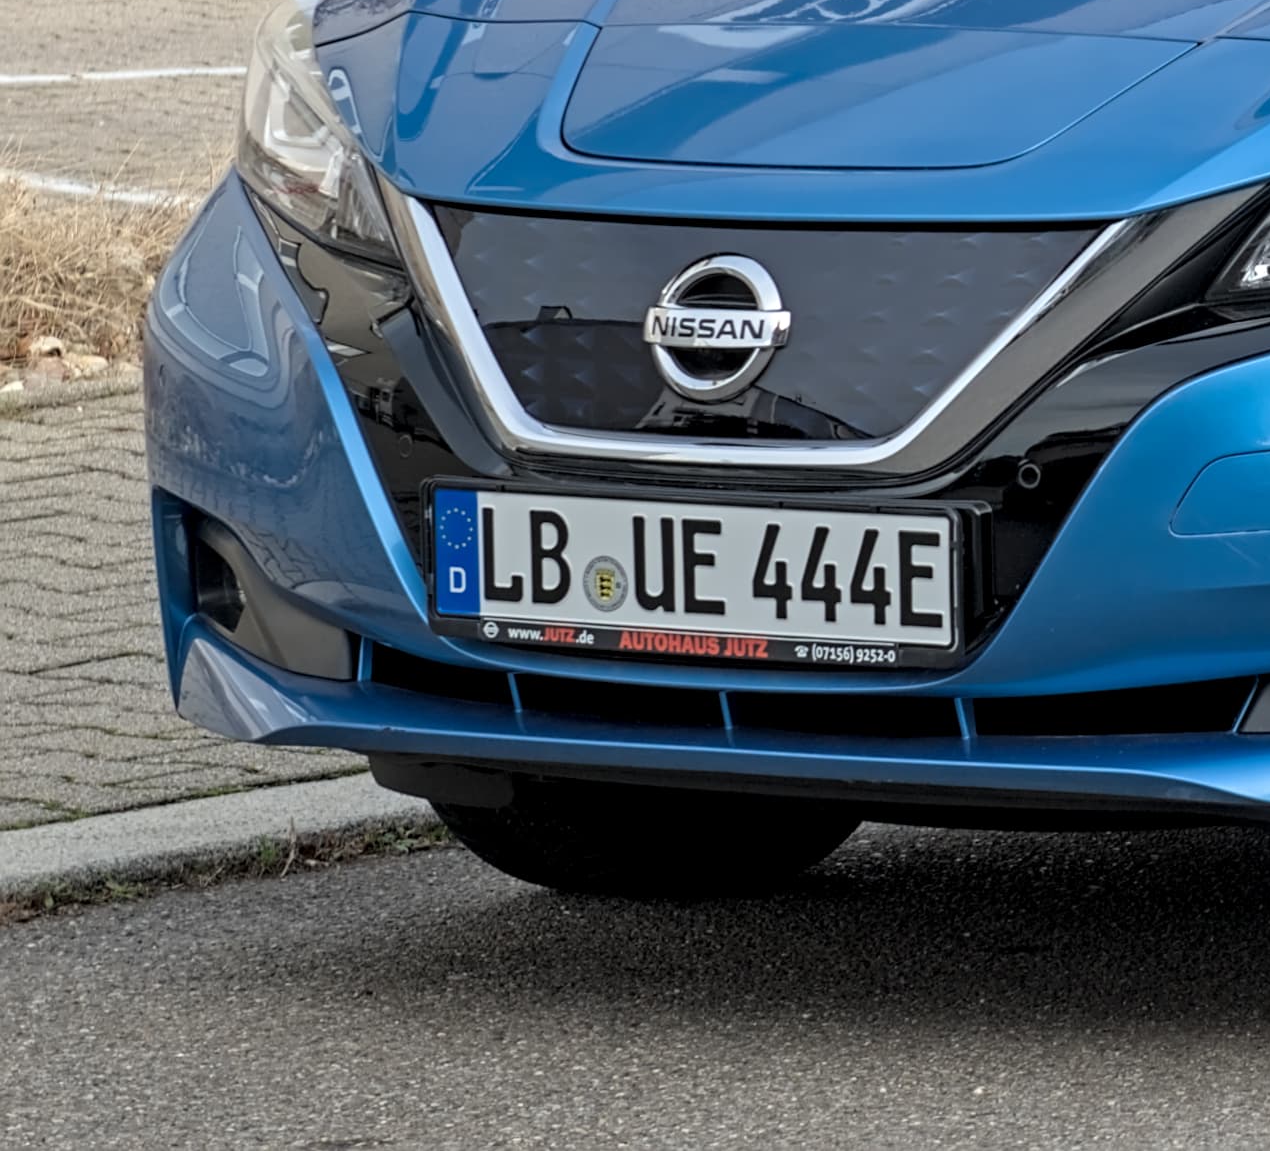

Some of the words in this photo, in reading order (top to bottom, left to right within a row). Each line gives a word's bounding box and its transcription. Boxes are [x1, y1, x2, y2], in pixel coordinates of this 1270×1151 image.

[651, 315, 766, 340] NISSAN
[449, 566, 467, 594] D
[481, 506, 572, 605] LB
[632, 515, 726, 615] UE
[751, 523, 944, 628] 444E
[507, 626, 595, 645] www.JUTZ.de
[619, 630, 720, 656] AUTOHAUS
[724, 637, 768, 658] JUTZ
[811, 642, 855, 664] (07156)
[856, 649, 896, 663] 9252-0
